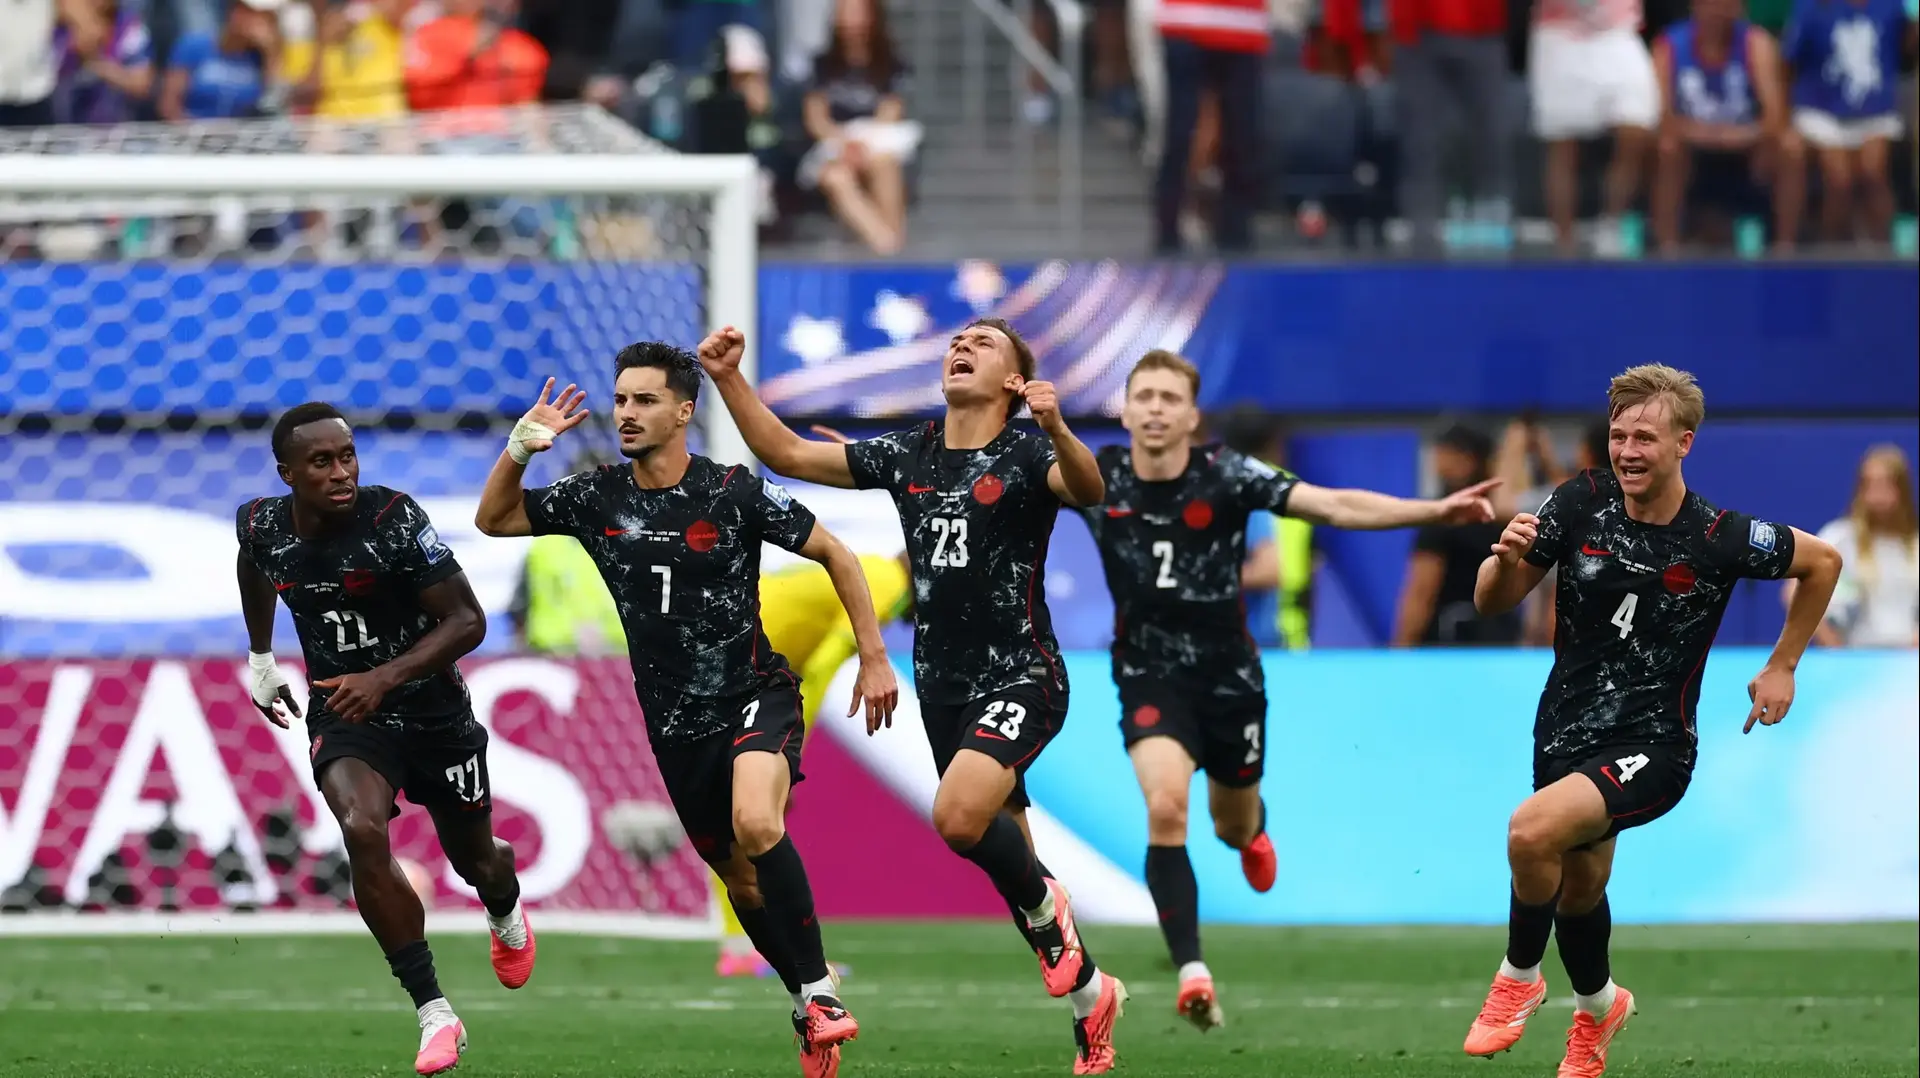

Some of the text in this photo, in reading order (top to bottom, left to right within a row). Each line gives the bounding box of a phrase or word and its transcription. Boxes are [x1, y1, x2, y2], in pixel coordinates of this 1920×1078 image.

[687, 532, 716, 540] CANADA
[931, 517, 968, 567] 23
[1152, 540, 1178, 588] 2
[651, 565, 671, 613] 7
[320, 610, 380, 652] 22
[1610, 592, 1638, 639] 4
[742, 700, 760, 728] 7
[978, 700, 1026, 740] 23
[1614, 752, 1650, 784] 4
